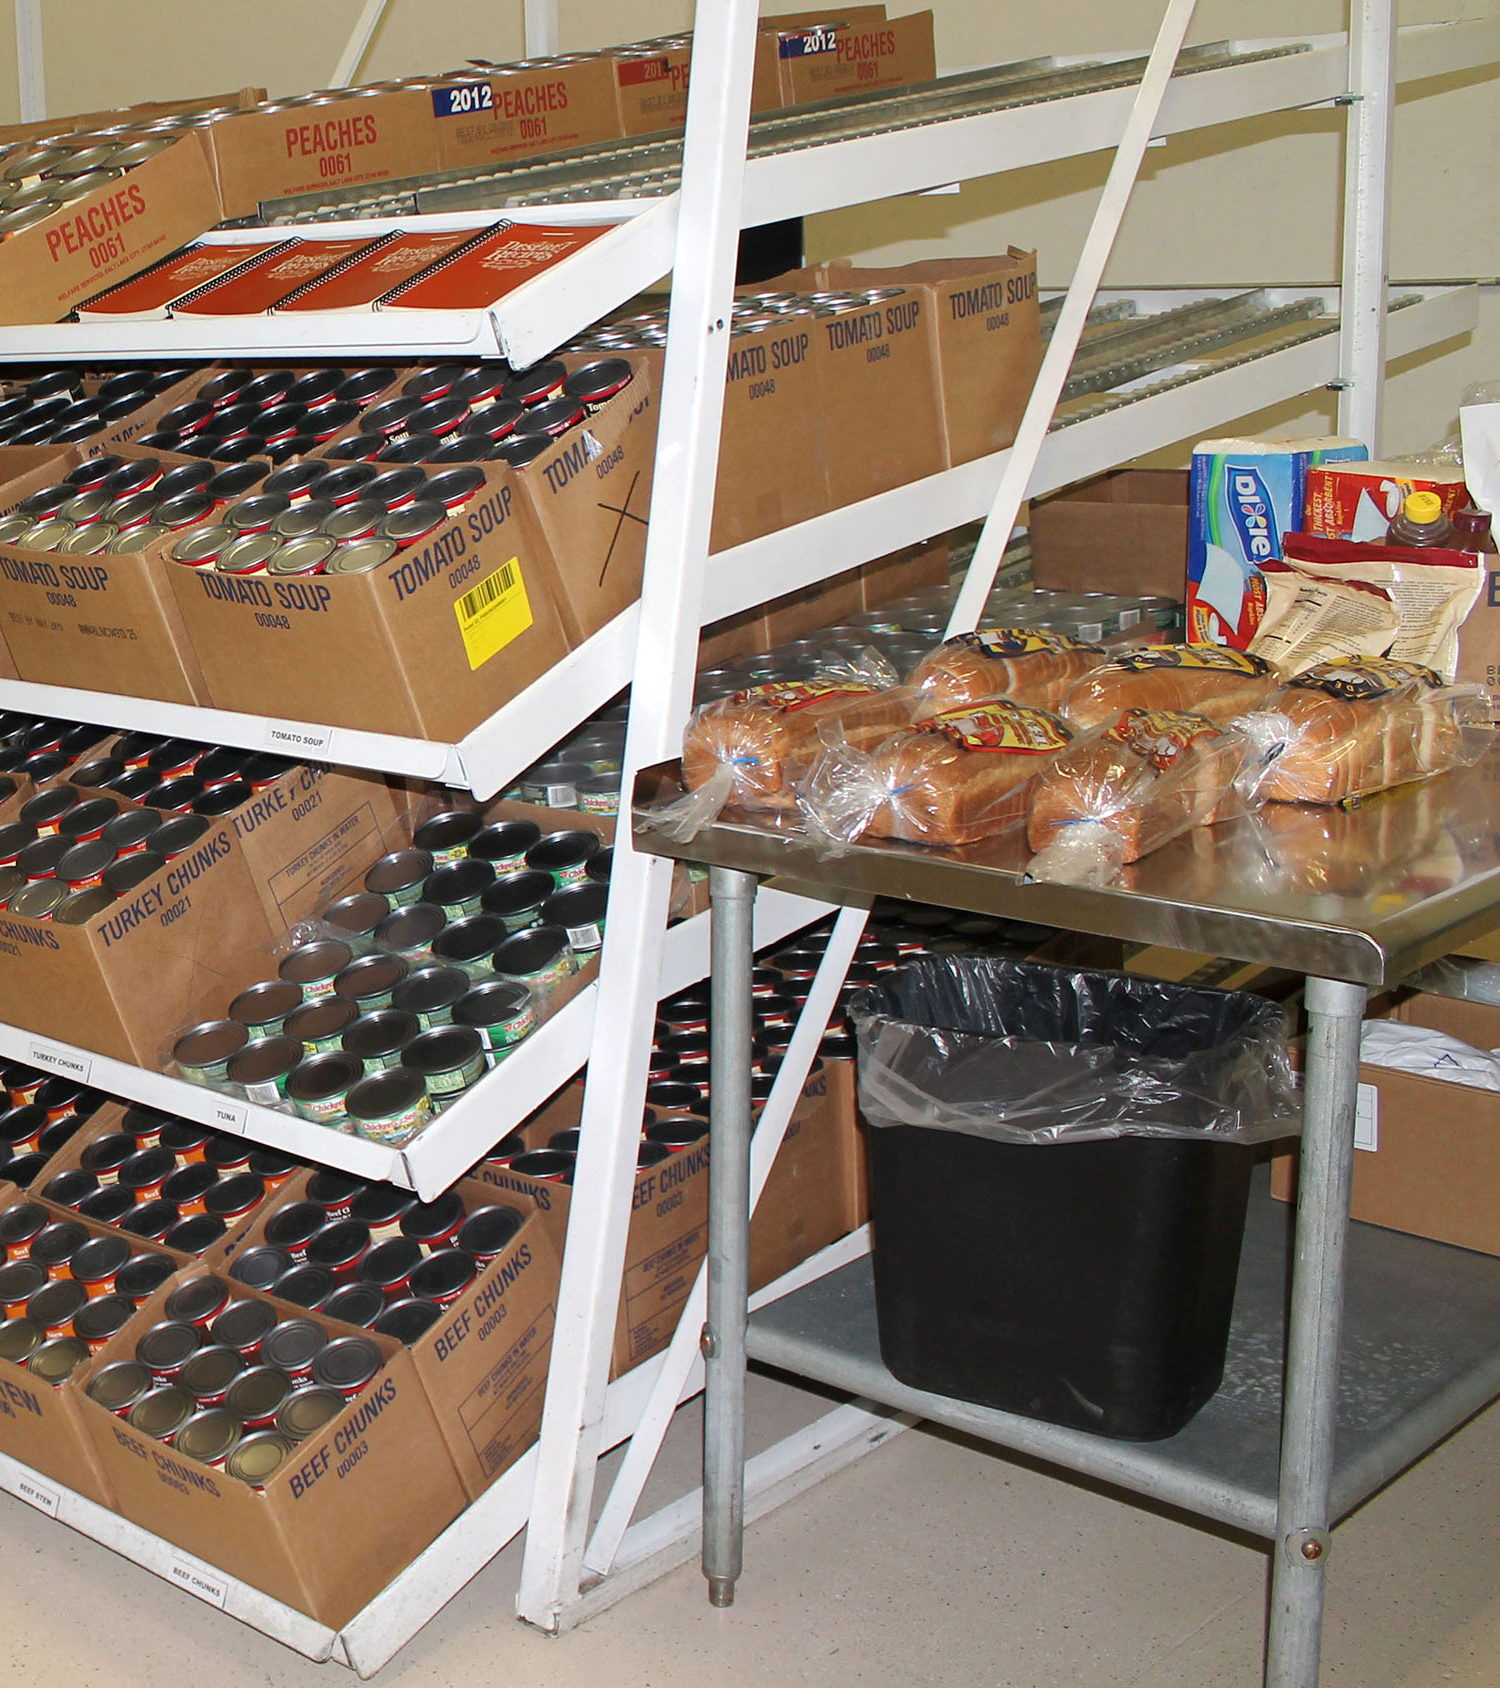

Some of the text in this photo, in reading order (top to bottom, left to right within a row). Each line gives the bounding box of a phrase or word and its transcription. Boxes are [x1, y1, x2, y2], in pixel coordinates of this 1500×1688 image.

[803, 31, 836, 54] 2012
[836, 32, 896, 65] PEACHES
[857, 61, 879, 81] 0061
[450, 85, 493, 113] 2012
[491, 82, 568, 121] PEACHES
[285, 114, 379, 158] PEACHES
[520, 117, 548, 140] 0061
[319, 151, 353, 178] 0061
[45, 184, 147, 263] PEACHES
[89, 232, 126, 269] 0061
[949, 271, 1038, 321] TOMATO SOUP
[826, 301, 920, 352] TOMATO SOUP
[986, 312, 1010, 332] 00048
[726, 333, 810, 383] MATO SOUP
[866, 343, 891, 364] 00048
[748, 378, 776, 400] 00048
[542, 430, 596, 495] TOMA
[596, 445, 625, 480] 00048
[1323, 475, 1335, 527] ABSORBENT
[388, 485, 512, 601] TOMATO SOUP
[60, 565, 109, 592] SOUP
[449, 554, 481, 589] 00048
[1250, 576, 1263, 601] MOST
[46, 592, 77, 608] 00048
[196, 571, 331, 612] TOMATO SOUP
[255, 612, 291, 629] 00048
[271, 730, 324, 747] TOMATO SOUP
[292, 791, 324, 823] 00021
[285, 856, 310, 878] TURKEY
[308, 837, 334, 859] CHUNKS
[332, 831, 340, 841] IN
[339, 815, 359, 836] WATER
[97, 883, 164, 948] TURKEY
[166, 831, 232, 897] CHUNKS
[160, 895, 192, 928] 00021
[33, 1050, 84, 1073] TURKEY CHUNKS
[216, 1109, 237, 1123] TUNA
[632, 1177, 656, 1211] EEF
[433, 1243, 533, 1362] BEEF CHUNKS
[477, 1303, 508, 1342] 00003
[288, 1377, 397, 1500] BEEF CHUNKS
[112, 1426, 221, 1498] BEEF CHUNKS
[336, 1443, 370, 1480] 00003
[19, 1482, 52, 1506] BEEF STEW
[172, 1566, 221, 1598] BEEF CHUNKS
